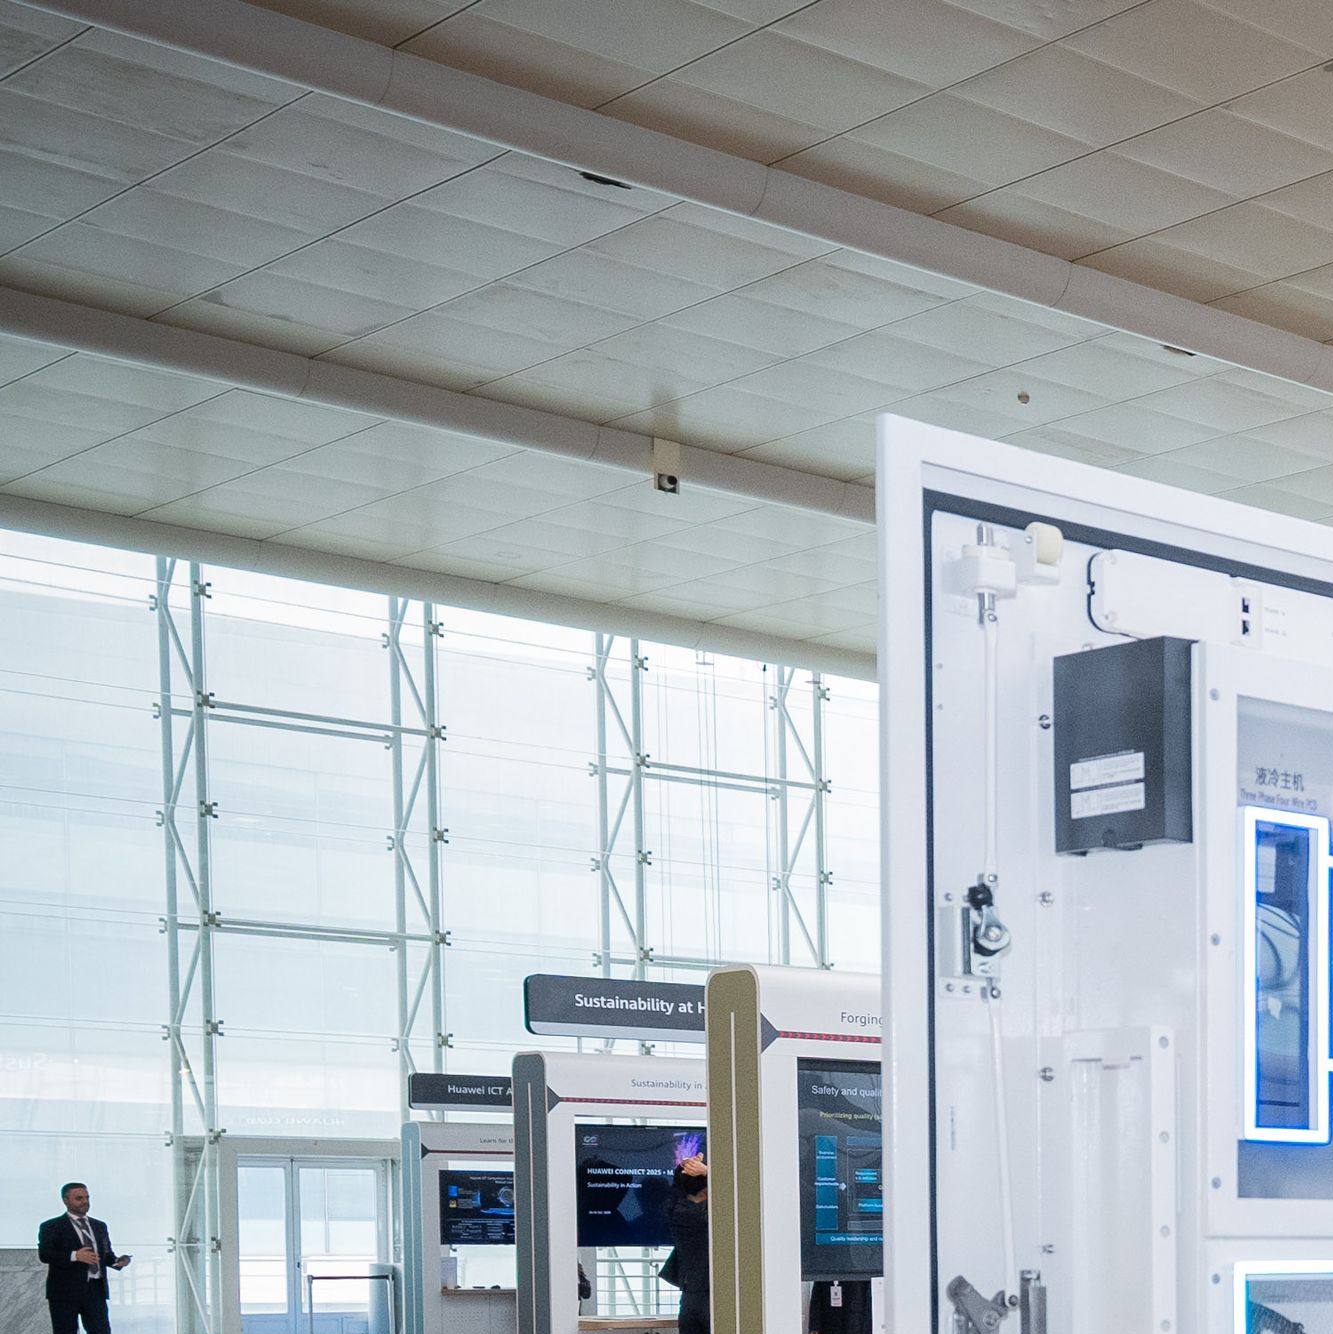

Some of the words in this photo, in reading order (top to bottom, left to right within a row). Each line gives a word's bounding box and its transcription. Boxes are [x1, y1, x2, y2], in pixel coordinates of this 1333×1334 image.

[1255, 766, 1305, 792] 液冷主机
[575, 993, 674, 1015] Sustainability
[678, 1002, 694, 1014] at
[447, 1084, 485, 1095] Huawei
[488, 1087, 503, 1095] ICT
[631, 1078, 692, 1091] Sustainability
[693, 1081, 702, 1090] in
[811, 1085, 839, 1097] Safety
[841, 1087, 857, 1096] and
[820, 1111, 852, 1120] Prioritizing
